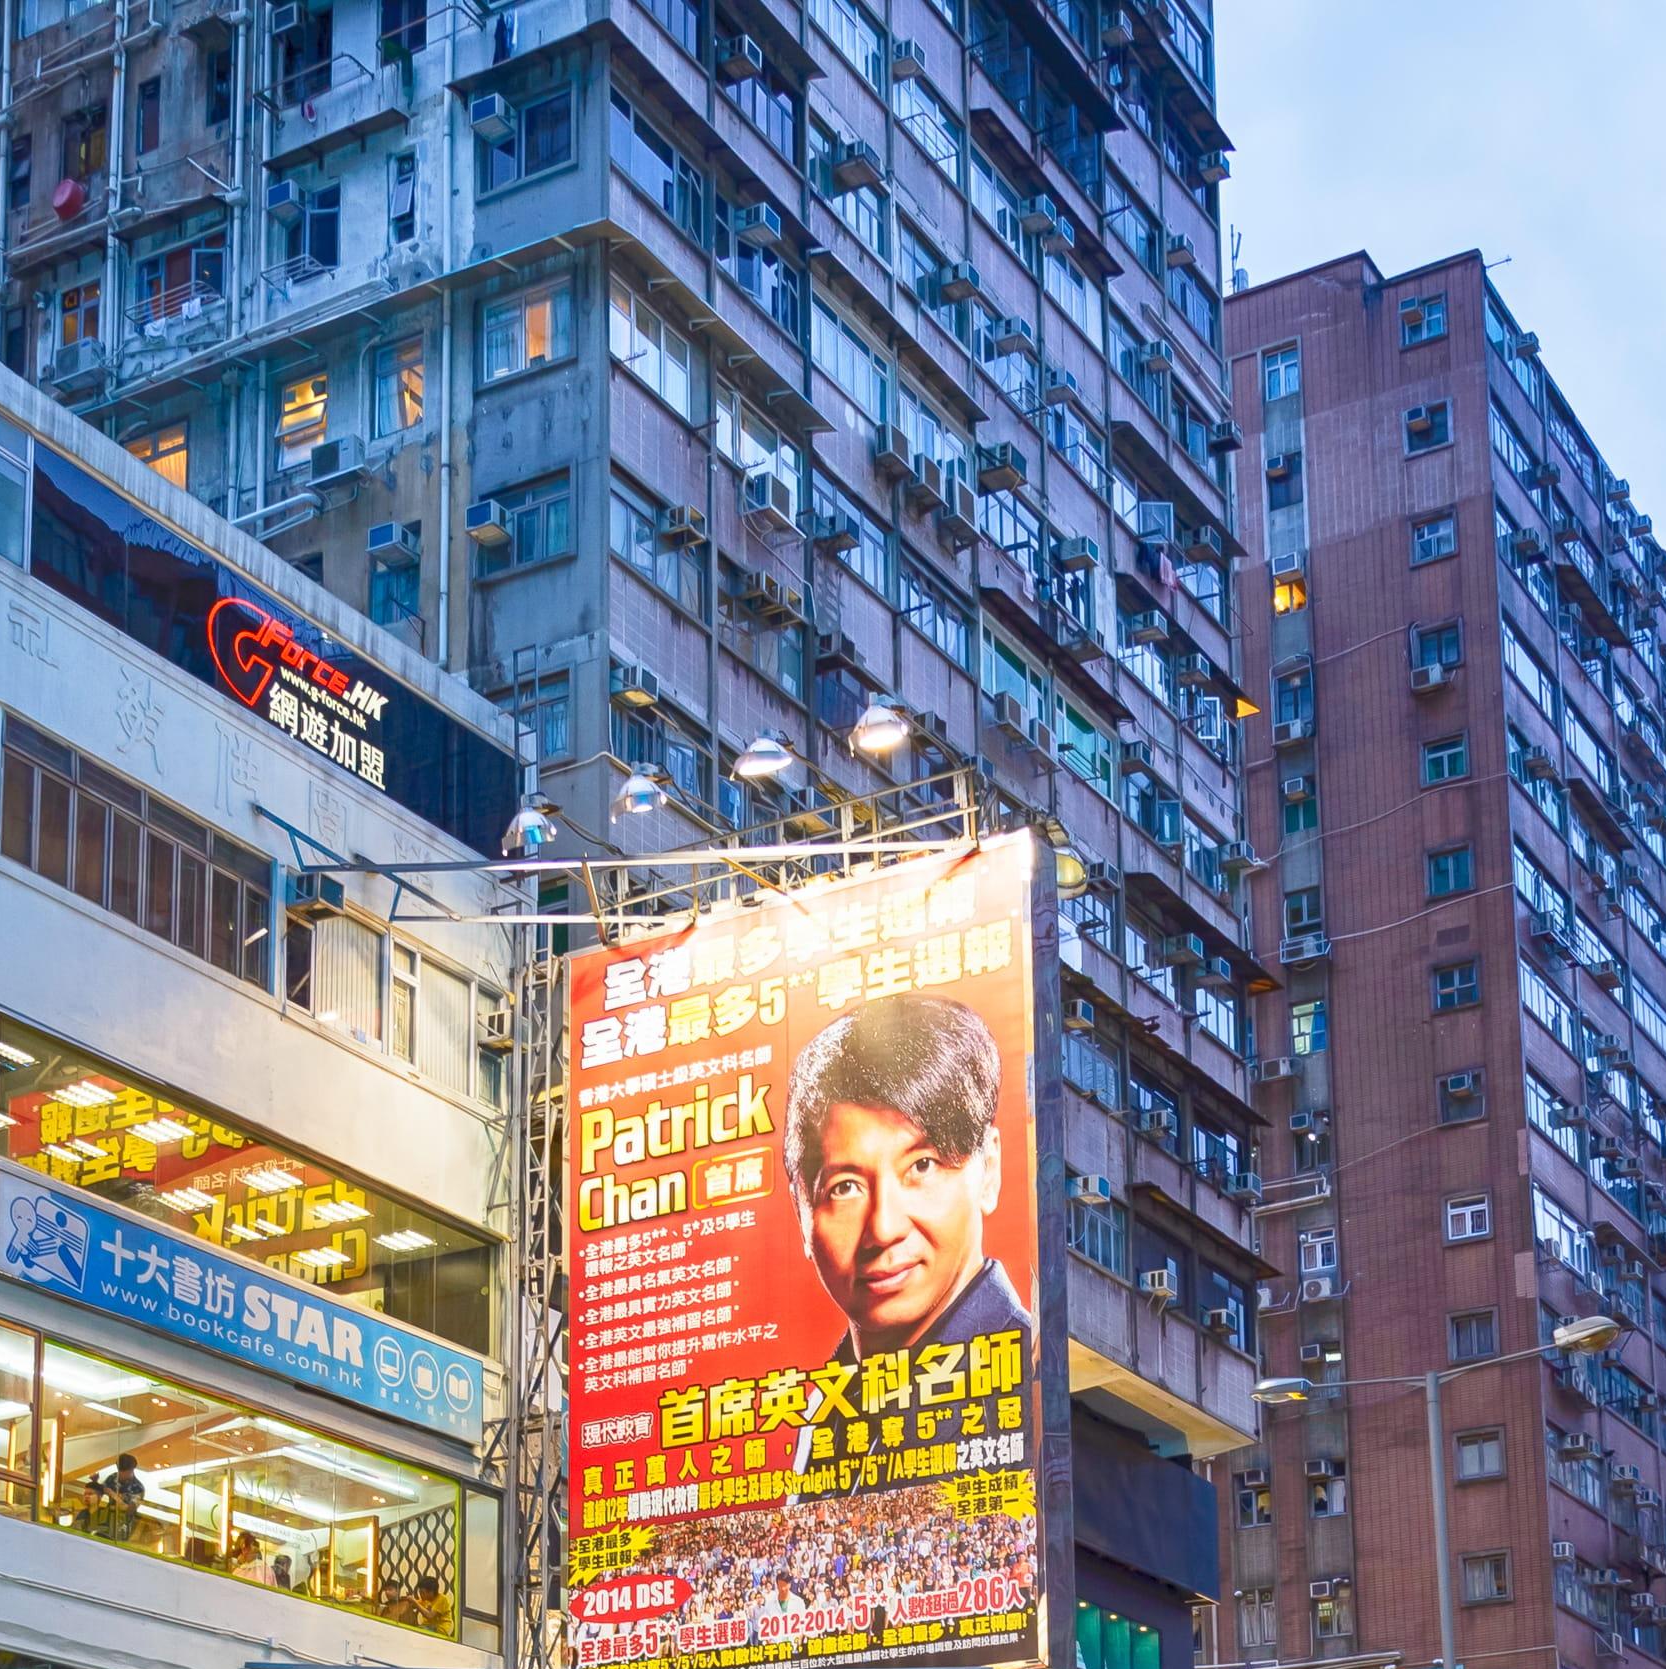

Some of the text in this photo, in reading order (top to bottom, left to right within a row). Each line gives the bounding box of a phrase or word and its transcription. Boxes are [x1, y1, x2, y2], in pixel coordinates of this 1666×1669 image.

[280, 666, 366, 731] www.g-force.hk
[268, 682, 385, 791] 網遊加盟
[579, 1074, 776, 1175] Patrick
[577, 1170, 687, 1233] Chan
[703, 1155, 764, 1199] 首席
[100, 1230, 365, 1368] 十大書坊 STAR
[101, 1281, 363, 1391] www.bookcafe.com.hk
[659, 1330, 1023, 1449] 首席英文科名師
[583, 1413, 653, 1447] 現代教育
[956, 1474, 1019, 1498] 學生成績
[956, 1496, 1020, 1517] 全港第一
[577, 1531, 633, 1556] 全港最多
[583, 1580, 676, 1617] 2014 DSE
